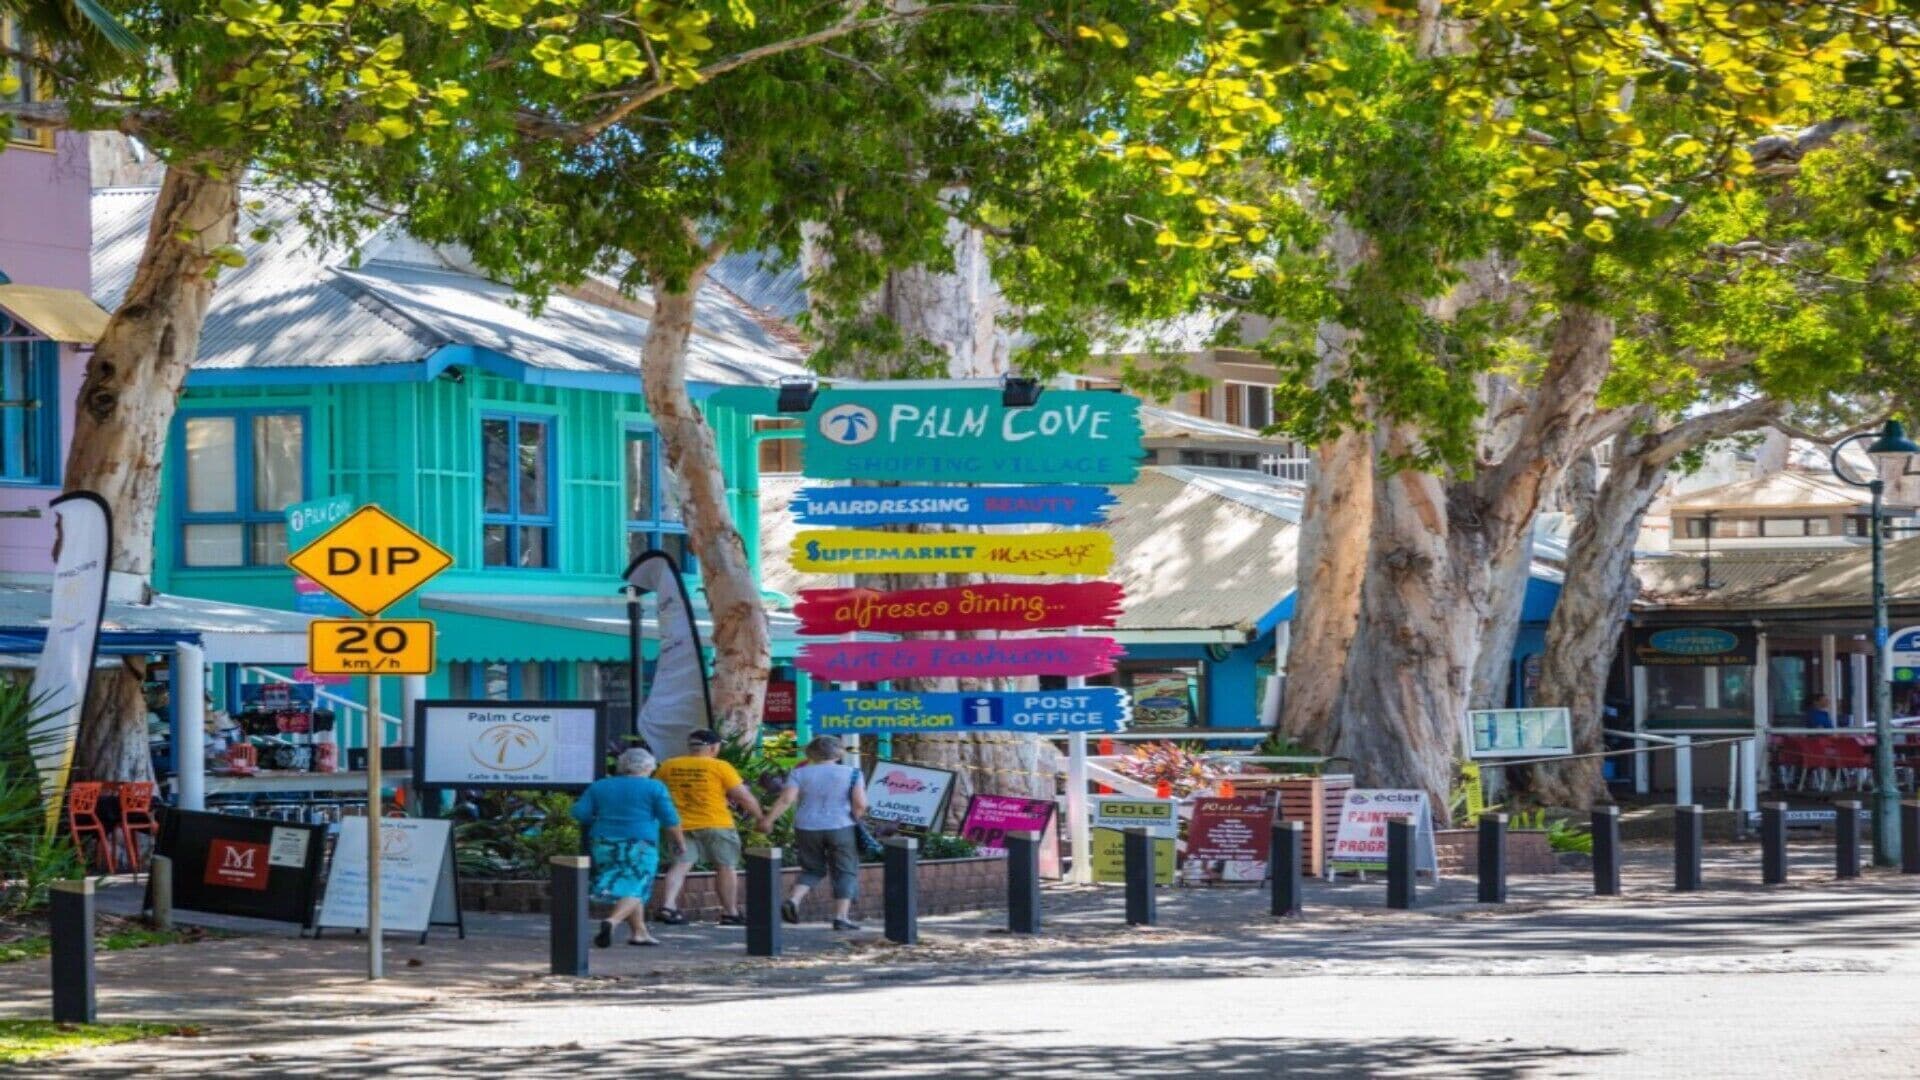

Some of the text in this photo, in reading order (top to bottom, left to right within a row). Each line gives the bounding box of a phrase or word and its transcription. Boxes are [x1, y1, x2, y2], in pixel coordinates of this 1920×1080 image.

[888, 403, 1112, 443] PALM COVE
[848, 456, 1112, 475] SHOPPING VILLAGE
[807, 496, 1078, 516] HAIRDRESSING BEAUTY
[805, 539, 977, 563] SUPERMARKET
[328, 546, 421, 576] DIP
[834, 592, 950, 629] alfresco
[335, 626, 408, 655] 20
[342, 656, 401, 670] km/h
[826, 650, 884, 671] Art
[929, 643, 1072, 669] Fashion
[843, 696, 924, 712] Tourist
[1024, 695, 1091, 710] POST
[467, 711, 552, 723] Palm Cove
[821, 712, 955, 729] Information
[1013, 712, 1103, 726] OFFICE
[877, 775, 940, 795] Annie's
[870, 807, 928, 823] OUTIQUE
[877, 799, 921, 814] LADIES
[1104, 804, 1166, 816] COLE
[1369, 825, 1384, 838] IN
[1338, 840, 1386, 853] PROGR
[222, 845, 257, 870] M
